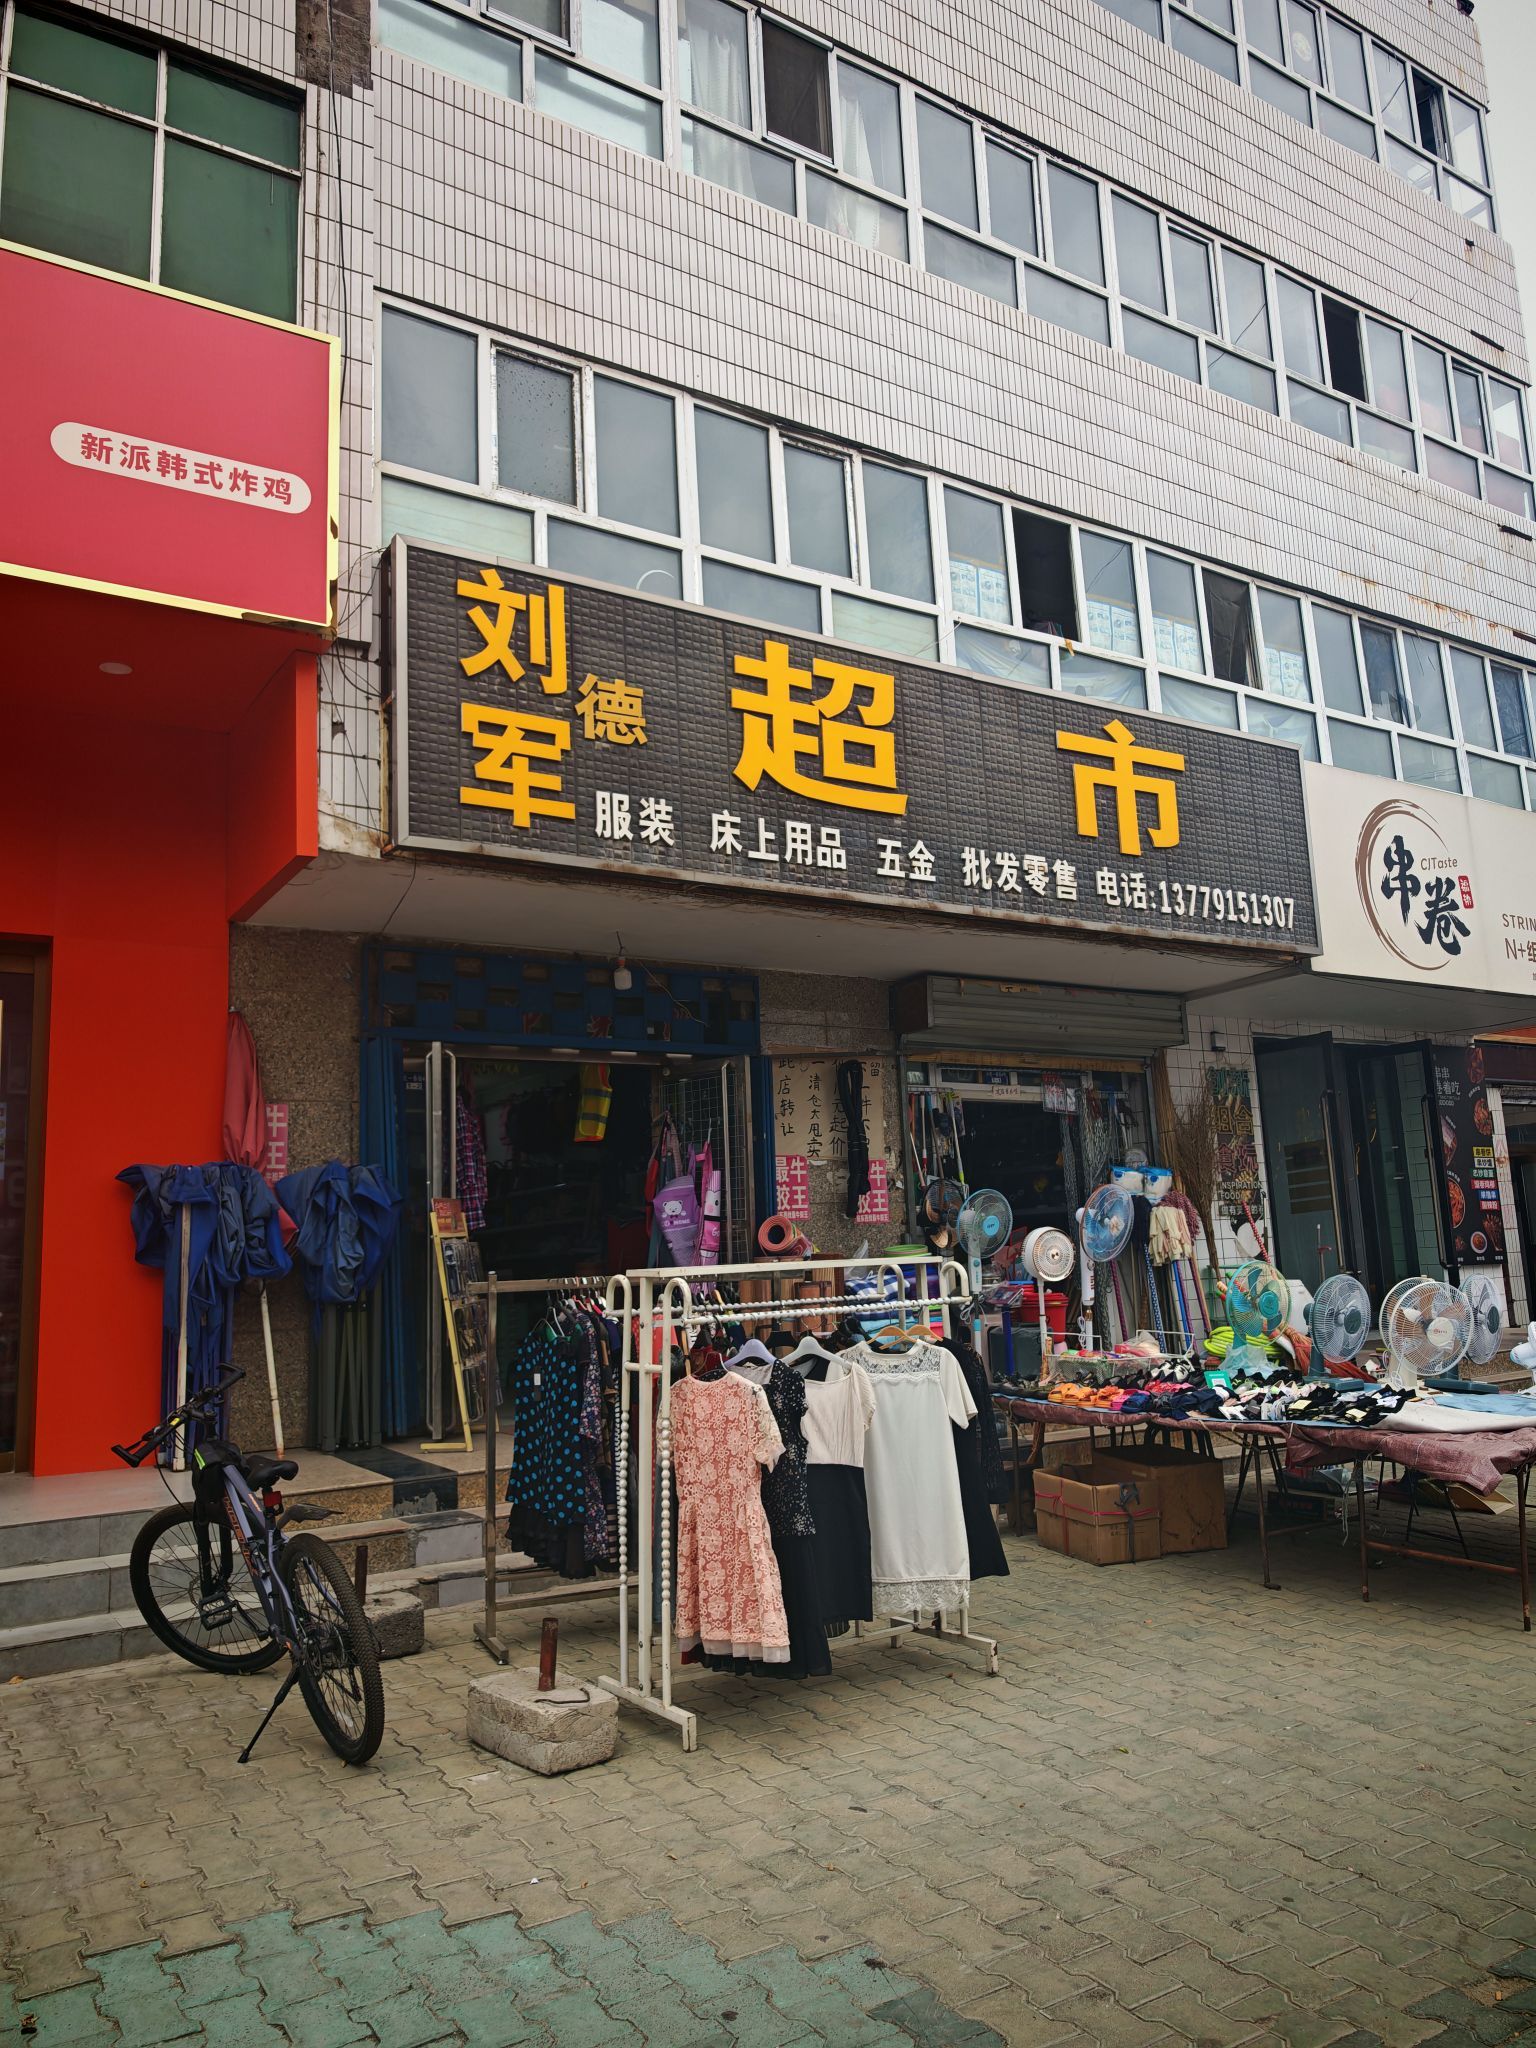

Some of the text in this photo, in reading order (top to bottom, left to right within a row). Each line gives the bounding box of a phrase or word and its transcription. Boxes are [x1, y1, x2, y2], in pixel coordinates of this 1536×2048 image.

[80, 432, 292, 505] 新派韩式炸鸡
[595, 791, 675, 846] 服装
[710, 810, 847, 870] 床上用品
[876, 838, 937, 882] 五金
[961, 846, 1078, 902] 批发零售
[777, 1058, 795, 1136] 此店转让
